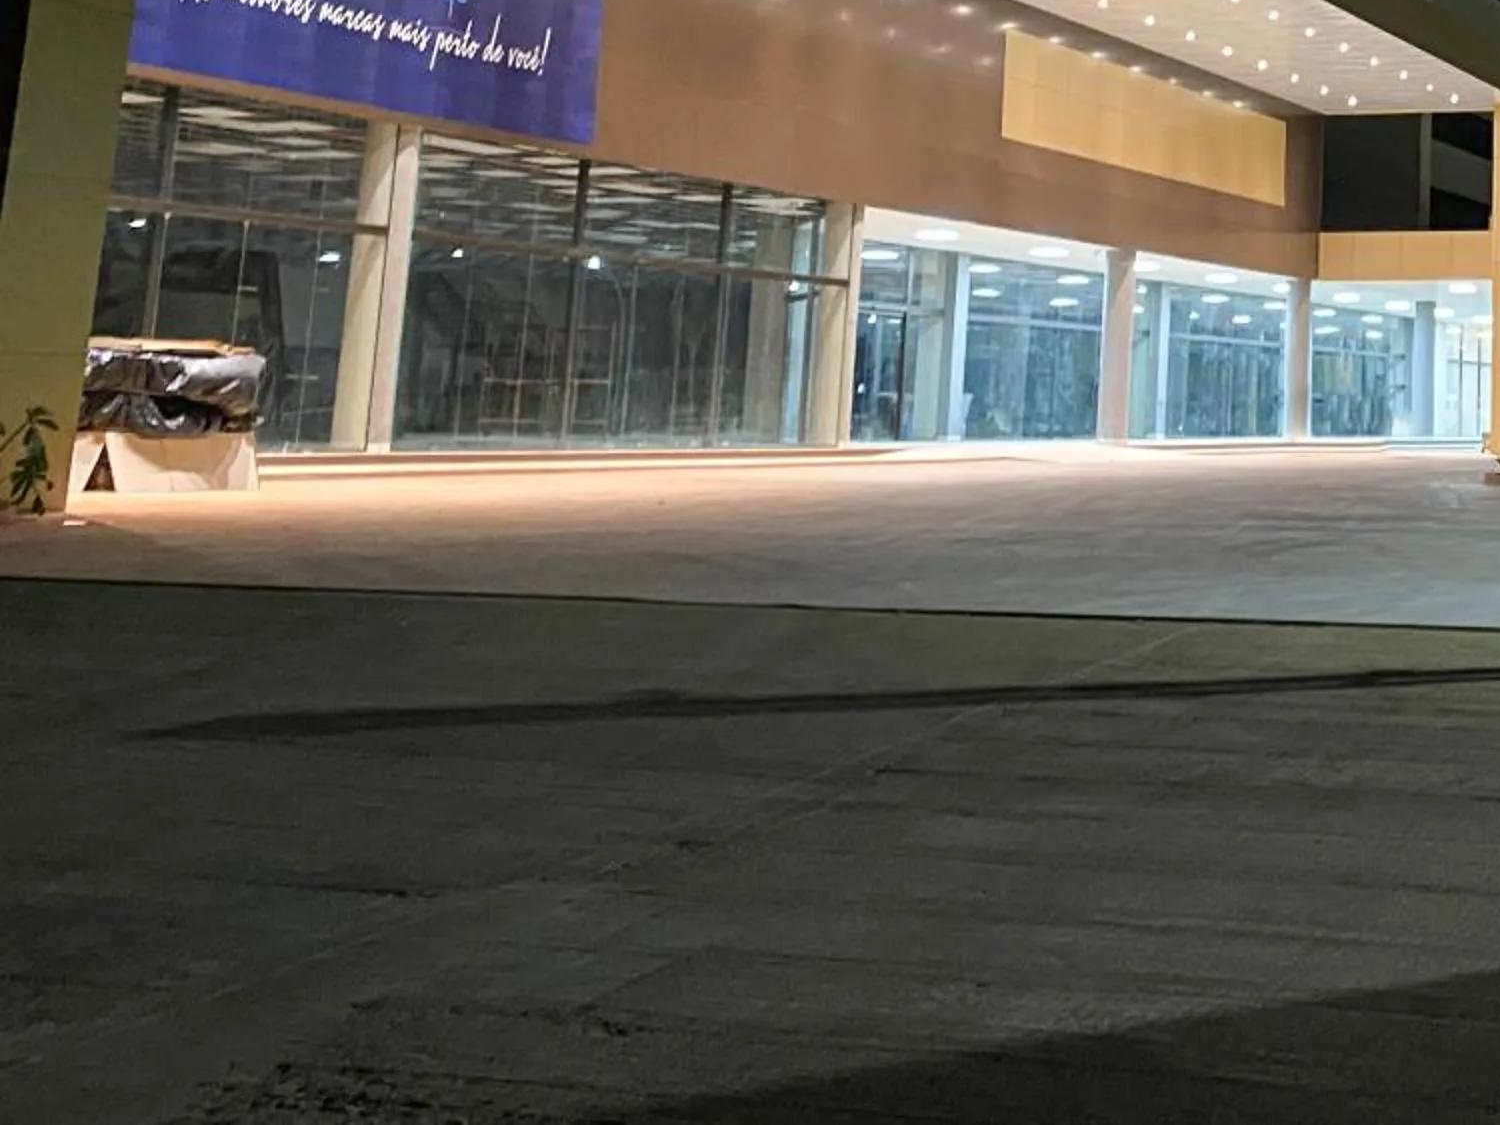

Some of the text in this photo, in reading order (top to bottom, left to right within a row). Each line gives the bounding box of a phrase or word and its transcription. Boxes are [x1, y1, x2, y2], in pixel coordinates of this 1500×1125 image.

[388, 19, 431, 52] mais
[429, 18, 482, 71] perto
[481, 12, 504, 64] de
